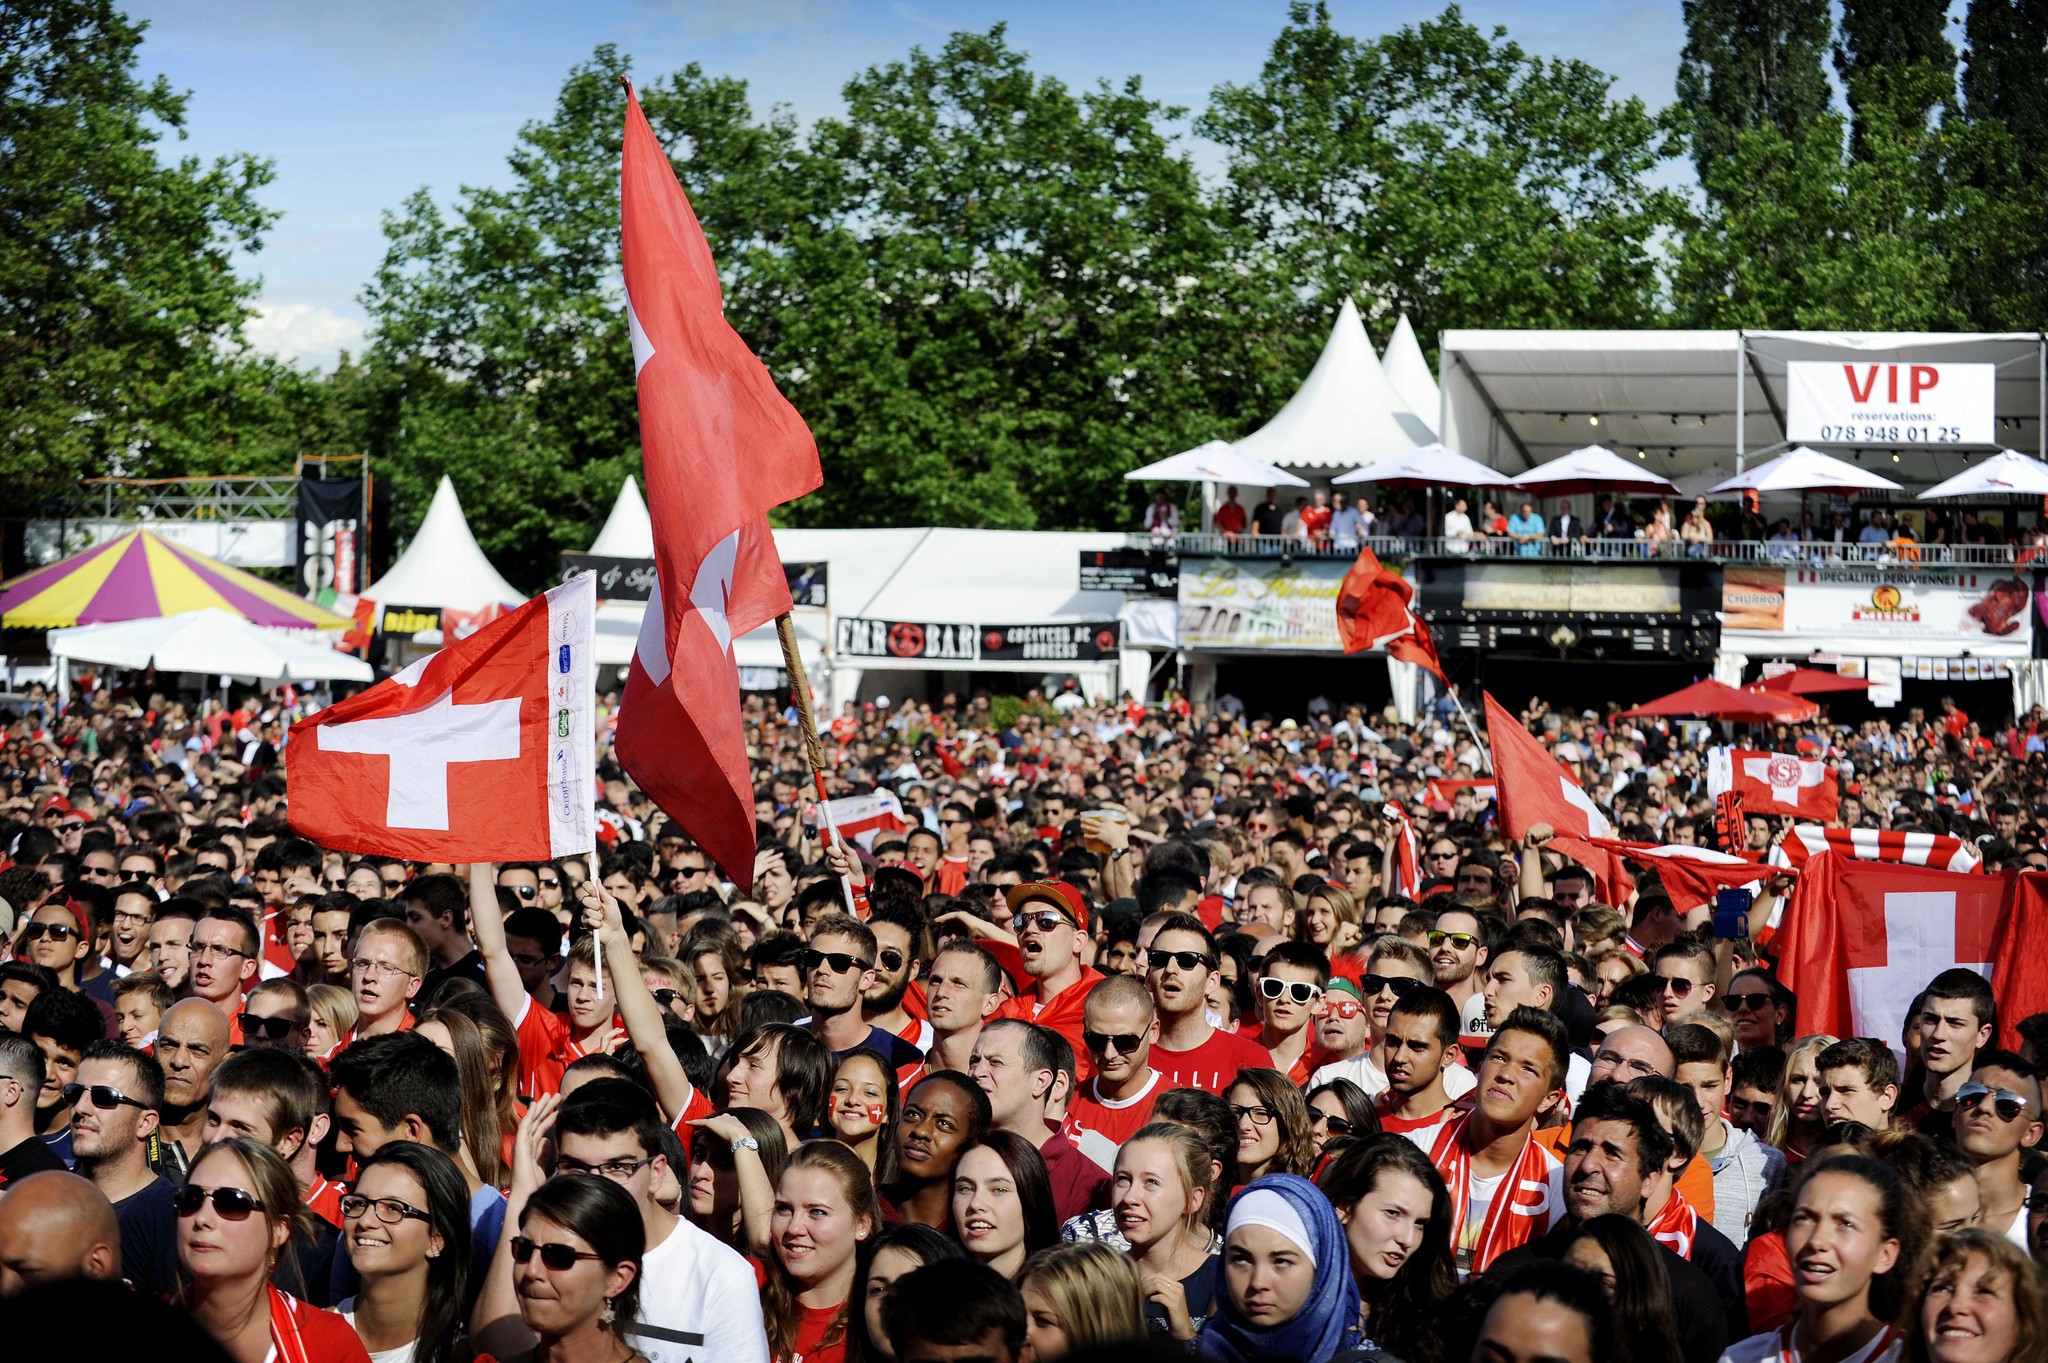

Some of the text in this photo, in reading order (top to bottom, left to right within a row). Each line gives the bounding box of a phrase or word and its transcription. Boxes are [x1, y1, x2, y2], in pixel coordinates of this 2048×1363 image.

[1843, 365, 1940, 403] VIP
[1851, 411, 1936, 421] réservations:
[1820, 425, 1961, 442] 078 948 01 25
[1727, 593, 1783, 605] CHURROS
[925, 624, 974, 658] BAR
[561, 785, 571, 816] CREDIT
[150, 1136, 159, 1162] Nikon
